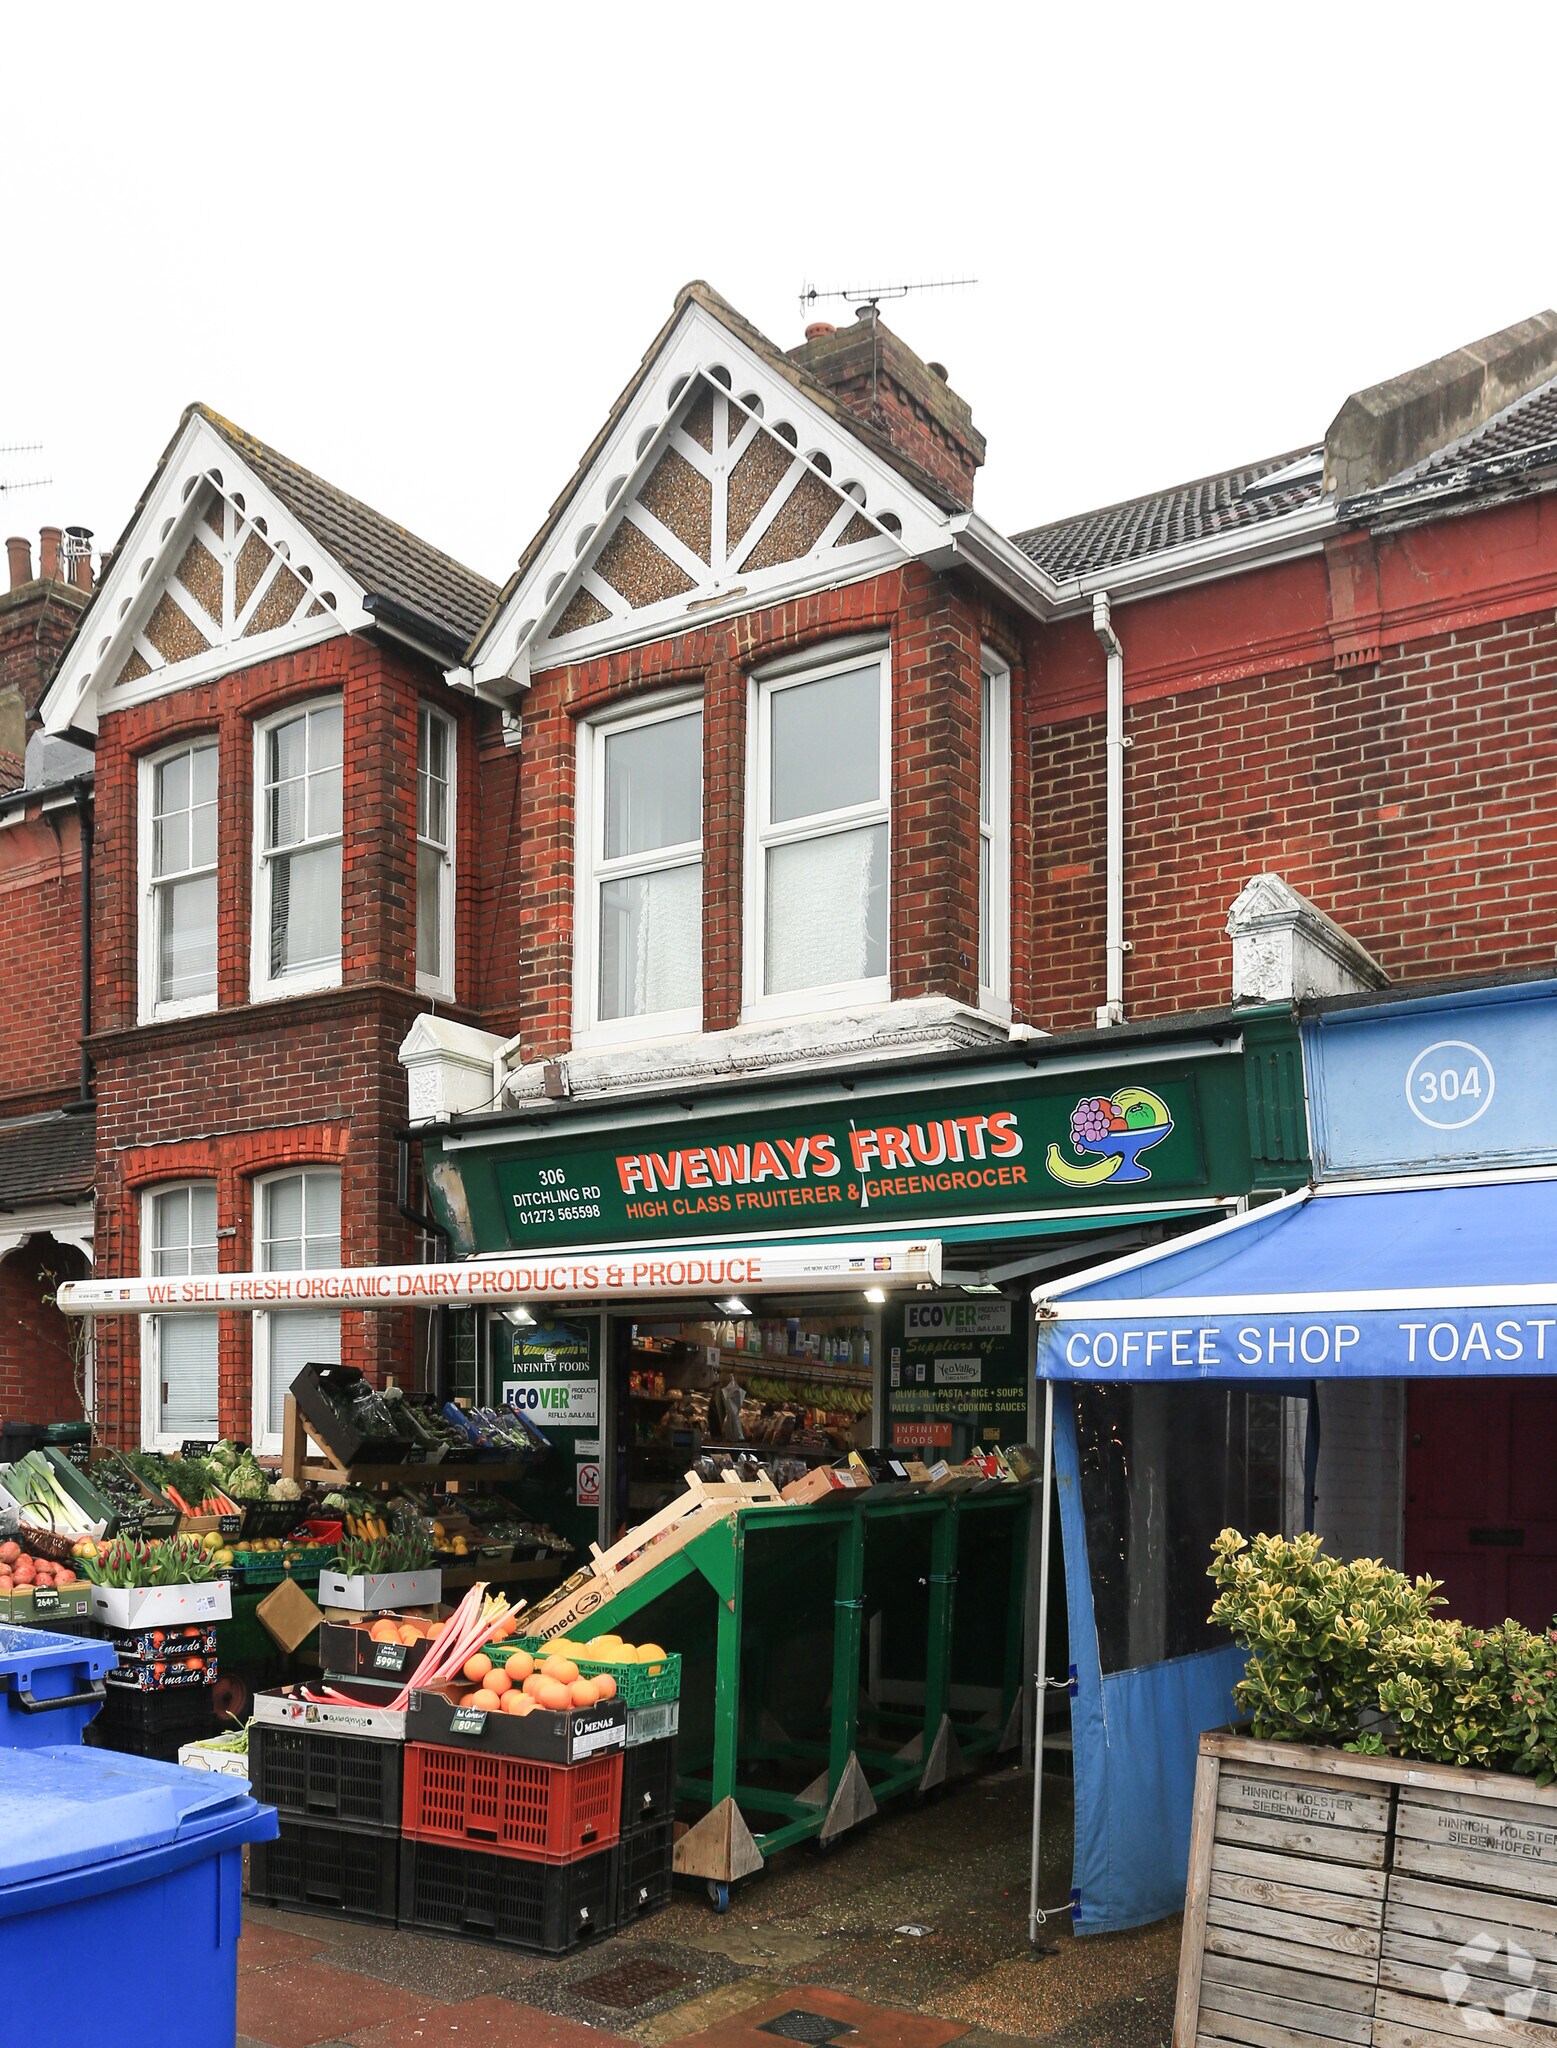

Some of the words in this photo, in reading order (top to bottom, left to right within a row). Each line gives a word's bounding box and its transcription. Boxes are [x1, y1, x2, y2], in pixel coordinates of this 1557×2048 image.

[1419, 1066, 1482, 1104] 304
[615, 1133, 841, 1196] FIVEWAYS
[848, 1111, 1024, 1172] FRUITS
[538, 1168, 566, 1187] 306
[513, 1188, 579, 1208] DITCHLING
[581, 1185, 601, 1201] RD
[625, 1200, 669, 1219] HIGH
[672, 1195, 732, 1215] CLASS
[736, 1183, 843, 1210] FRUITERER
[848, 1184, 860, 1200] &
[866, 1166, 1028, 1199] GREENGROCER
[520, 1209, 555, 1225] 01273
[557, 1204, 601, 1221] 565598
[147, 1282, 178, 1304] WE
[182, 1281, 225, 1303] SELL
[230, 1277, 291, 1301] FRESH
[296, 1273, 392, 1300] ORGANIC
[396, 1271, 460, 1297] DAIRY
[467, 1264, 599, 1294] PRODUCTS
[606, 1264, 625, 1287] &
[633, 1256, 763, 1288] PRODUCE
[909, 1305, 977, 1326] ECOVER
[977, 1305, 1006, 1313] PRODUCTS
[976, 1324, 1006, 1332] AVAILABLE
[905, 1338, 974, 1356] Suppliers
[1065, 1328, 1220, 1368] COFFEE
[1237, 1324, 1361, 1365] SHOP
[1398, 1319, 1556, 1363] TOAST
[513, 1362, 557, 1374] INFINITY
[559, 1361, 590, 1373] FOODS
[506, 1387, 570, 1410] ECOVER
[895, 1389, 917, 1399] OLIVE
[918, 1389, 930, 1398] OIL
[938, 1389, 963, 1398] PASTA
[971, 1388, 989, 1397] RICE
[996, 1388, 1024, 1397] SOUPS
[547, 1411, 567, 1419] REFILLS
[568, 1411, 596, 1419] AVAILABLE
[892, 1403, 915, 1412] PATES
[923, 1403, 950, 1412] OLIVES
[957, 1403, 993, 1412] COOKING
[995, 1402, 1026, 1412] SAUCES
[896, 1425, 950, 1433] INFINITY
[896, 1436, 933, 1444] FOODS
[541, 1609, 577, 1640] imed
[328, 1714, 367, 1727] Rhubarb
[1241, 1785, 1288, 1801] HINRICH
[1296, 1793, 1353, 1812] KOLSTER
[1252, 1799, 1336, 1822] SIEBENHÖFEN
[1438, 1816, 1490, 1834] HINRICH
[1448, 1832, 1543, 1857] SIEBENHÖFEN
